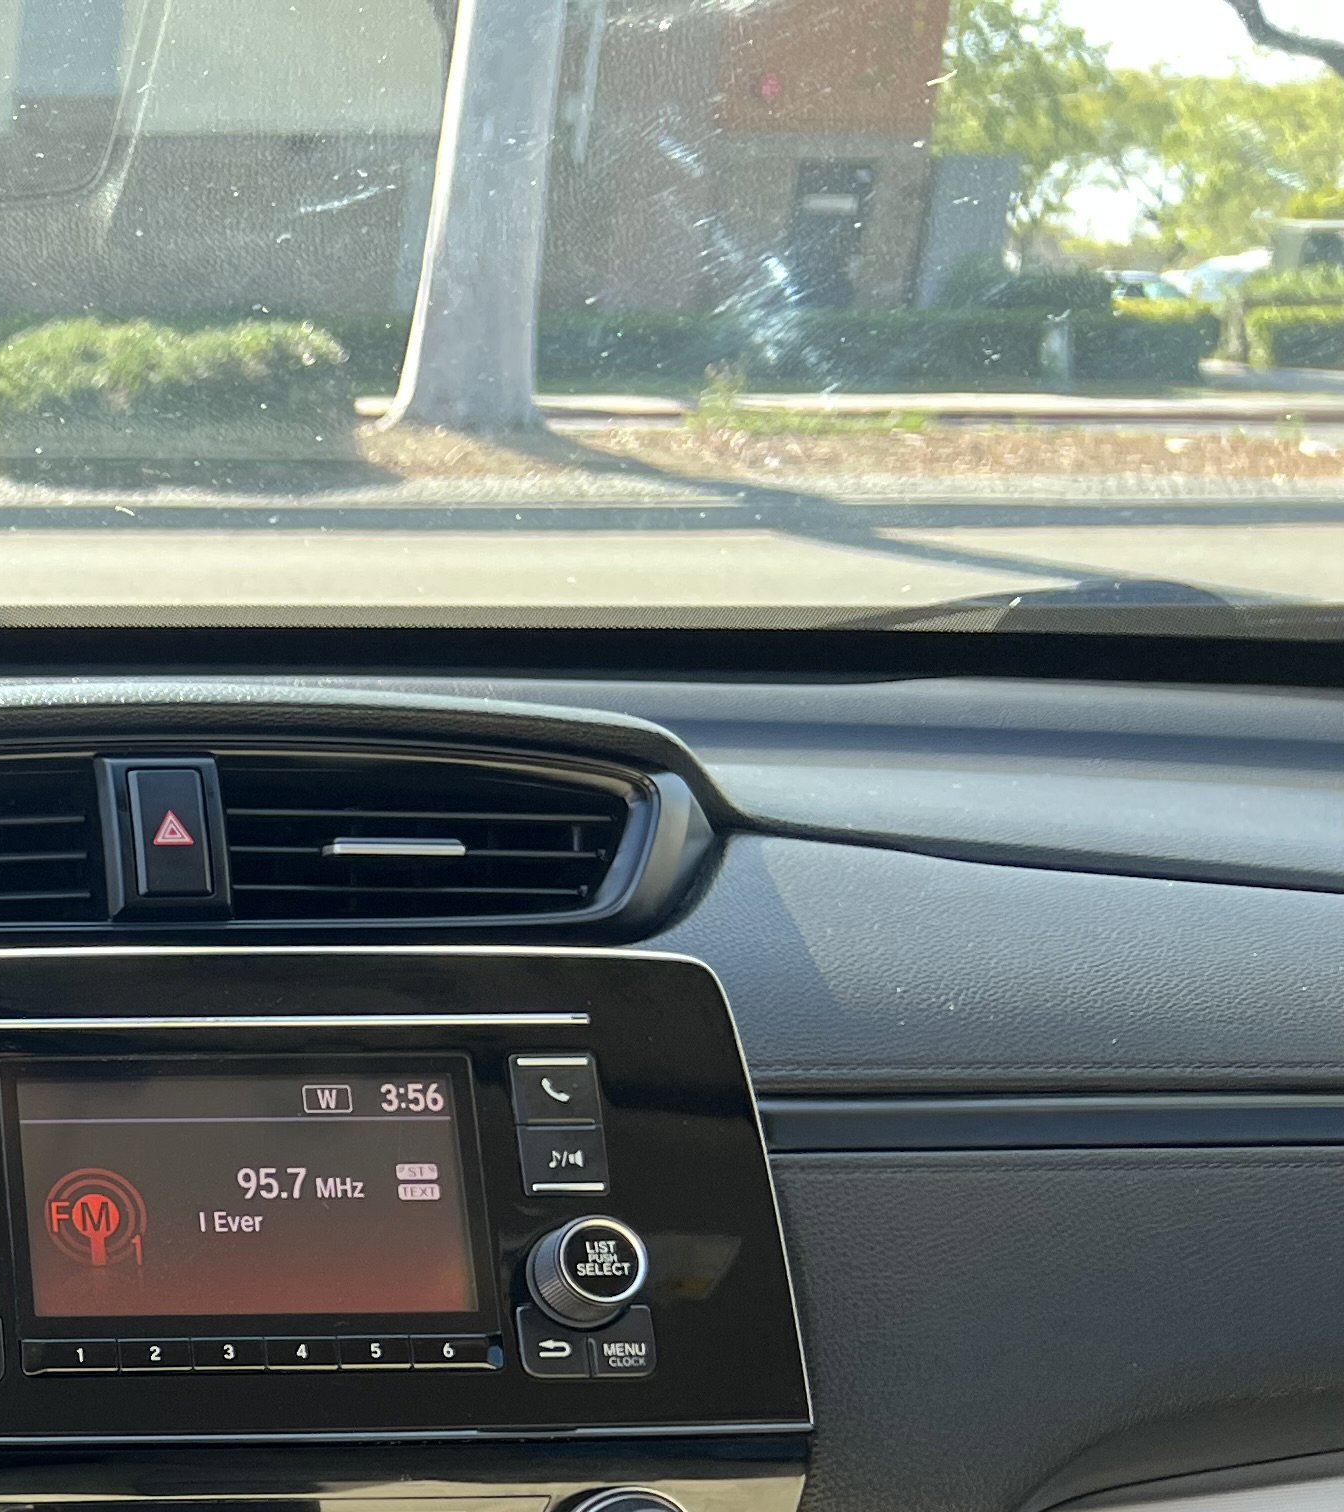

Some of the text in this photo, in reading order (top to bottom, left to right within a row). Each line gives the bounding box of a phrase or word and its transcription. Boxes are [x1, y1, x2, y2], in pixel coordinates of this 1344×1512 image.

[317, 1083, 444, 1112] W 3:56
[237, 1167, 365, 1199] 95.7 MHz
[402, 1186, 436, 1197] TEXT
[198, 1212, 263, 1233] I Ever
[586, 1241, 616, 1254] LIST
[588, 1254, 618, 1263] PUSH
[577, 1263, 631, 1277] SELECT
[76, 1343, 454, 1363] 1 2 3 4 5 6
[603, 1343, 646, 1357] MENU
[609, 1356, 646, 1367] CLOCK
